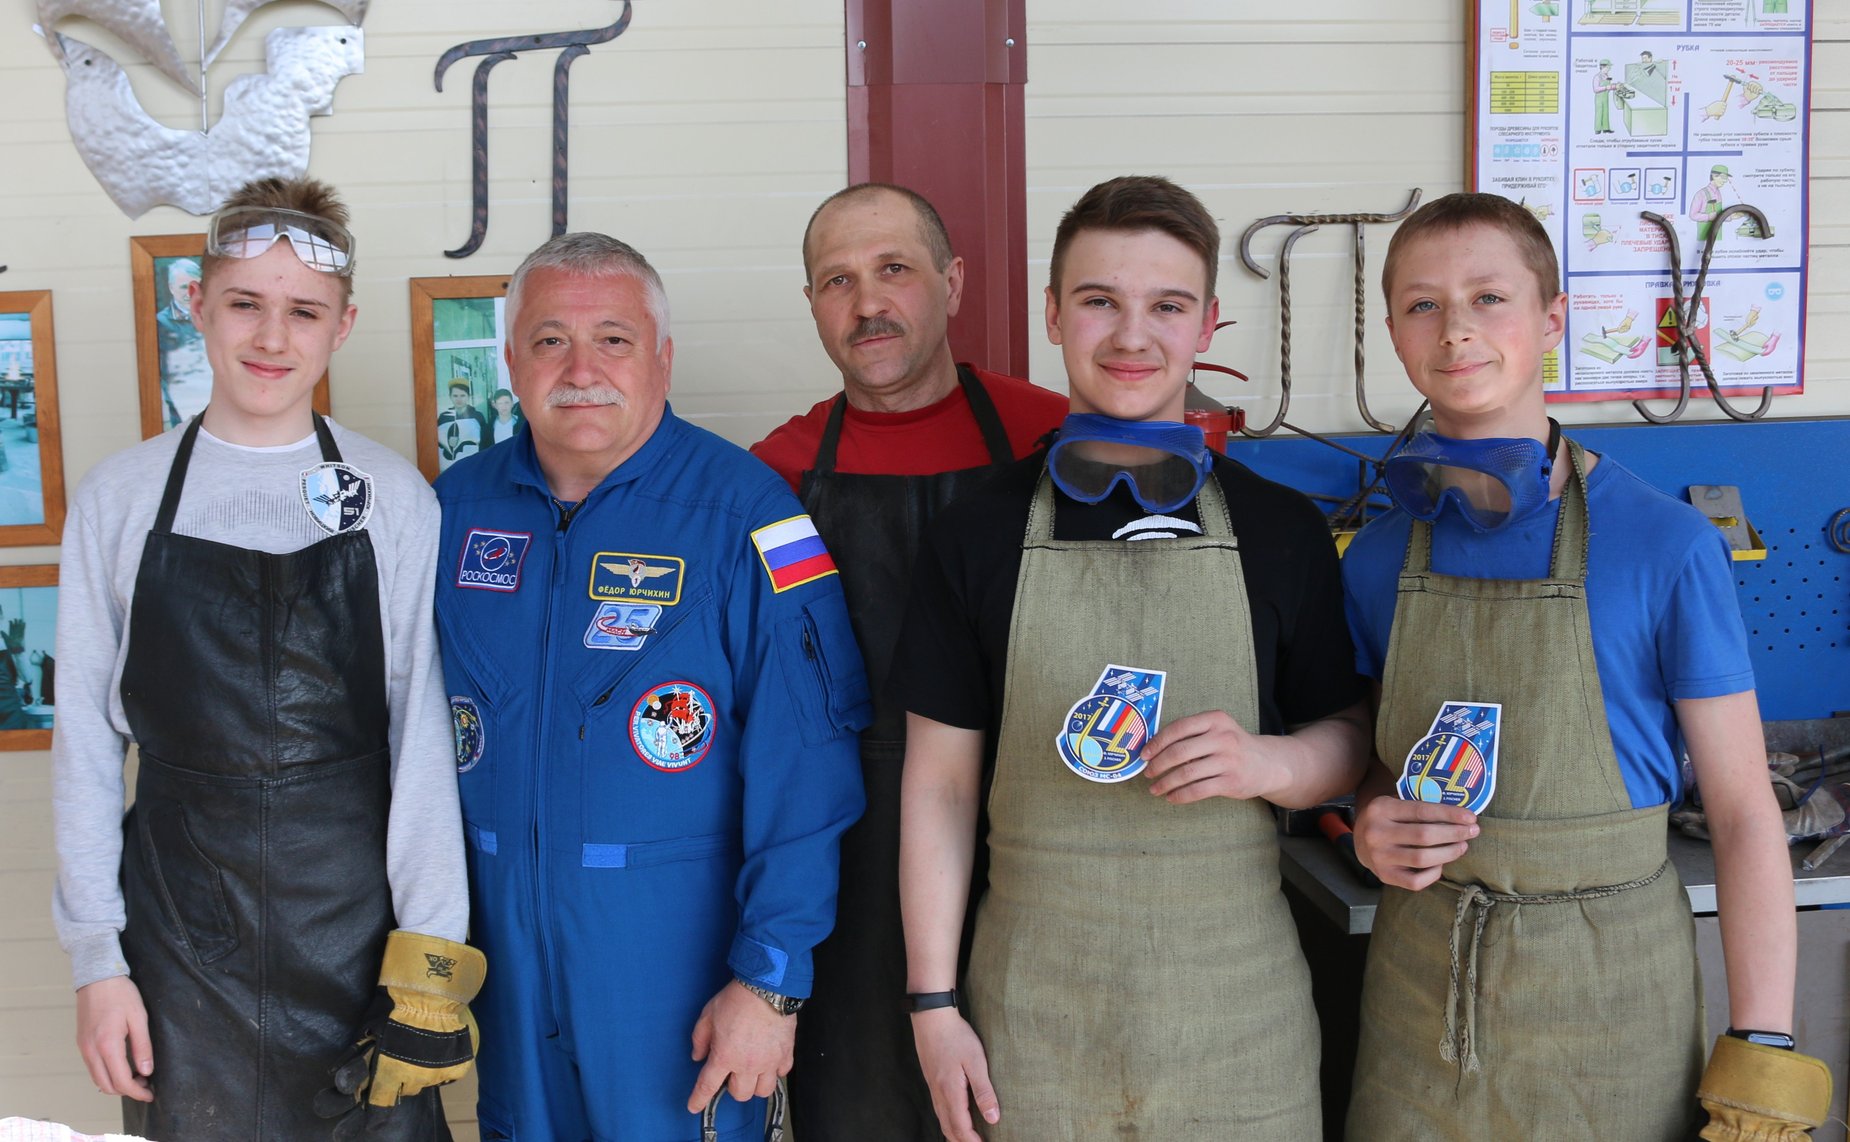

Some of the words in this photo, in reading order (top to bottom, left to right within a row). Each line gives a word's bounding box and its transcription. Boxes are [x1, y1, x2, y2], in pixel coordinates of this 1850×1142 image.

[301, 479, 309, 504] PESQUET
[344, 507, 360, 516] 51
[462, 570, 516, 585] РОСКОСМОС
[598, 585, 625, 594] ФЁДОР
[629, 589, 670, 598] ЮРЧИХИН
[1073, 712, 1092, 720] 2017
[667, 758, 691, 768] VIVUNT
[1079, 766, 1099, 777] СОЮЗ
